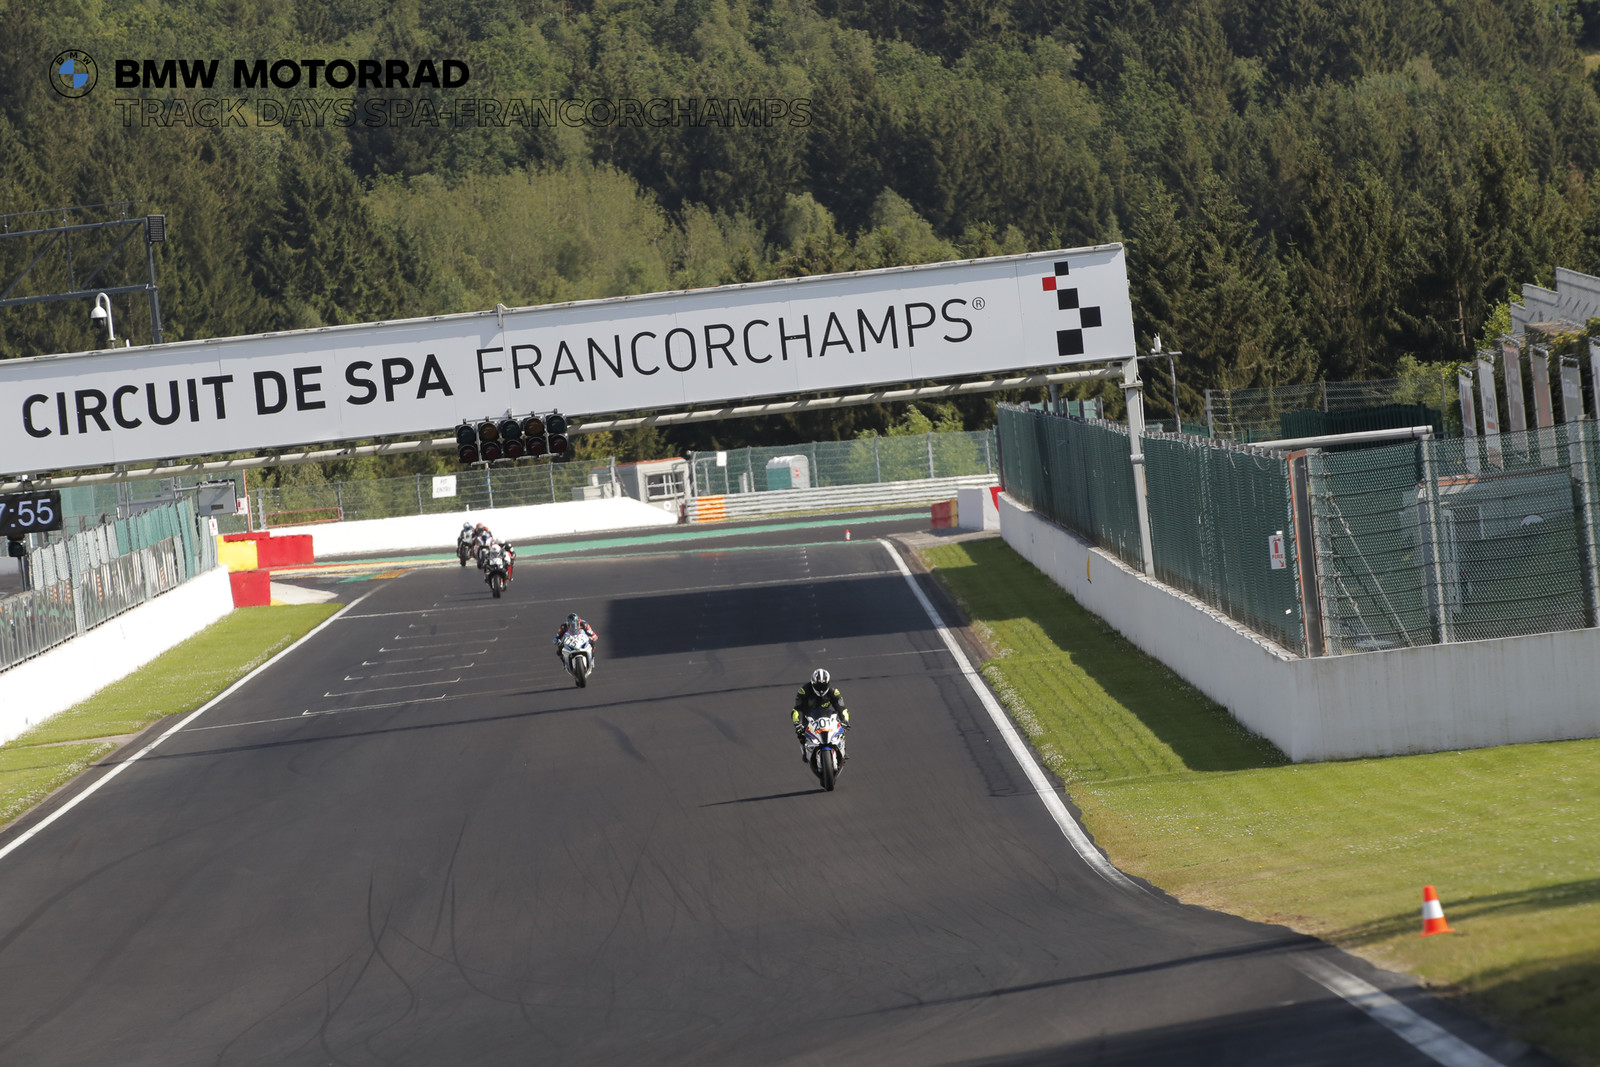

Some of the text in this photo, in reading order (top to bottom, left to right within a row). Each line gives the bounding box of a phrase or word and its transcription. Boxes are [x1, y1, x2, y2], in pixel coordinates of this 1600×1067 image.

[23, 374, 234, 439] CIRCUIT
[254, 365, 326, 416] DE
[346, 354, 454, 406] SPA
